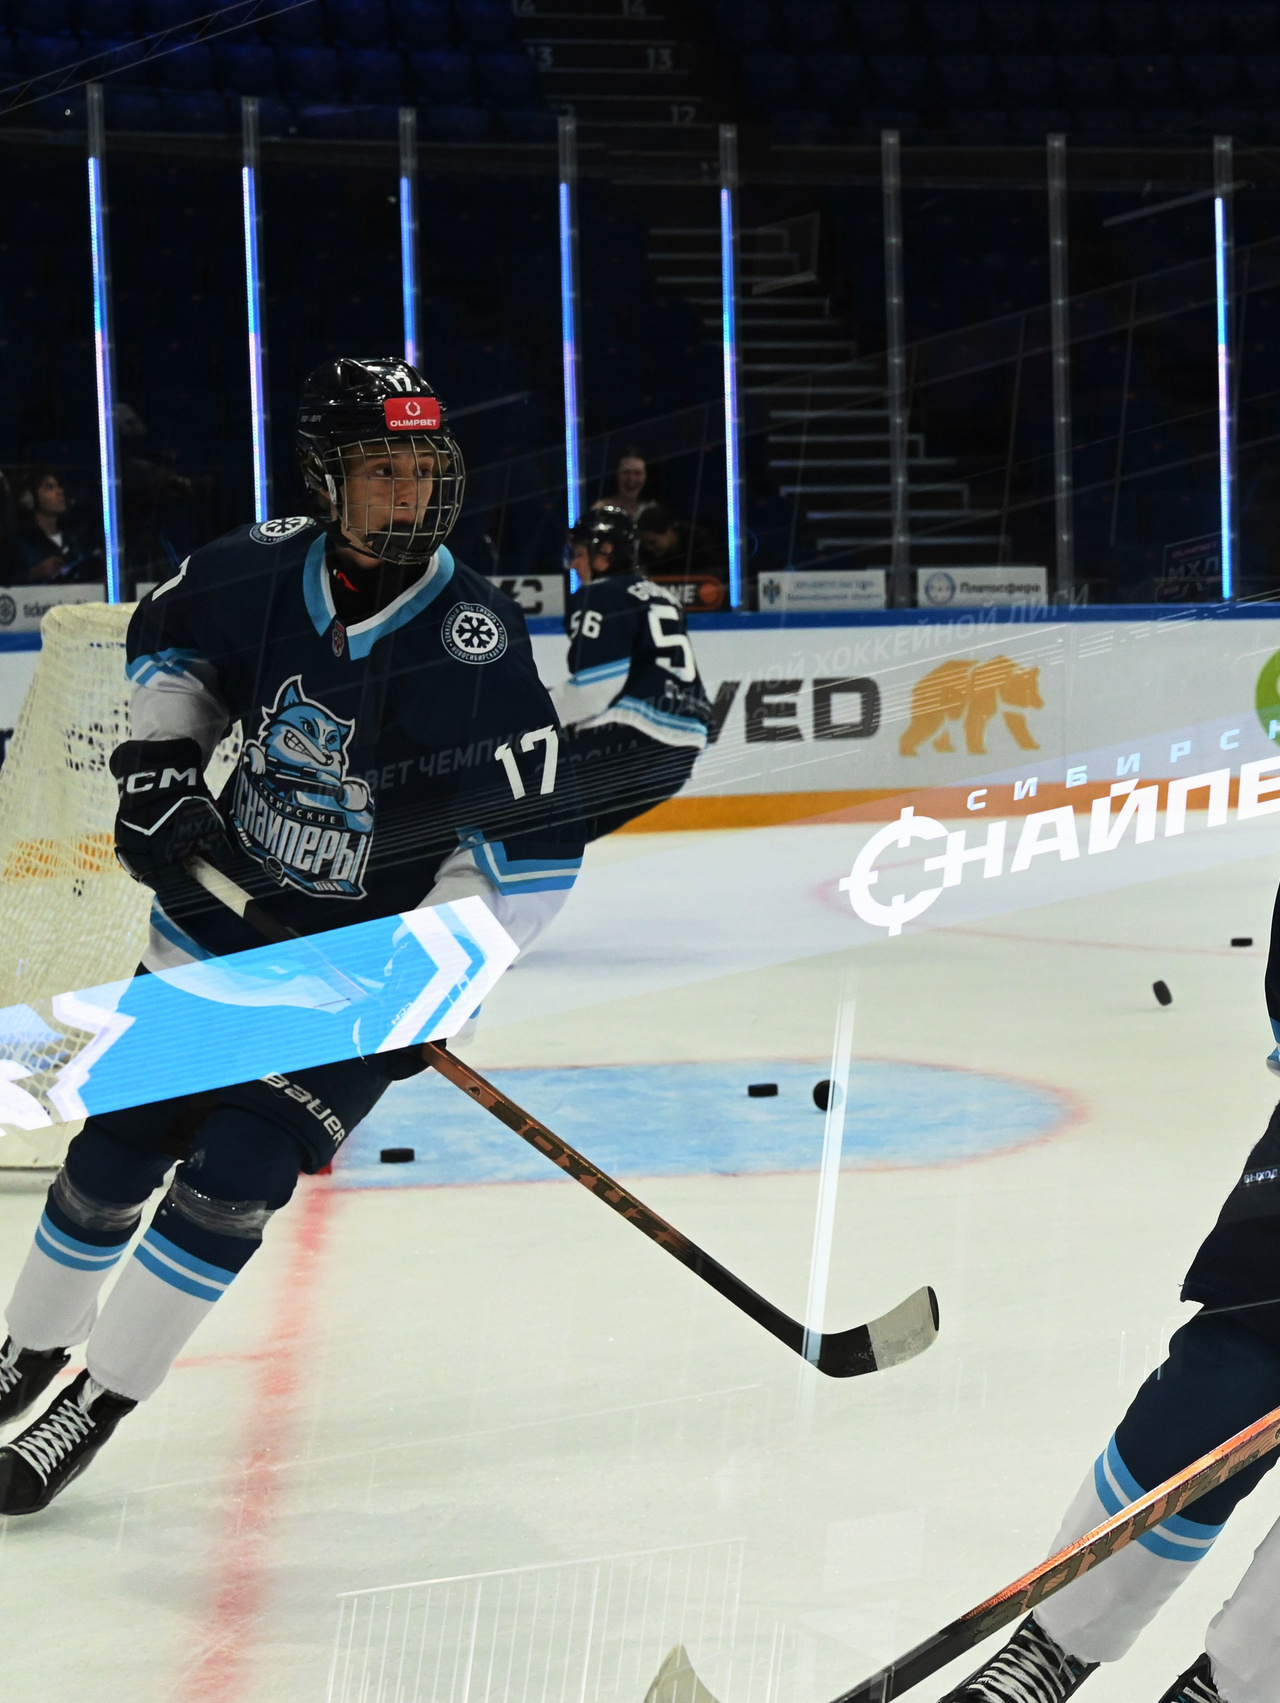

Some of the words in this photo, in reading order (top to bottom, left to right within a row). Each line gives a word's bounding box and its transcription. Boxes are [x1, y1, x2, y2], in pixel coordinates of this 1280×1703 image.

[646, 48, 673, 71] 13
[670, 105, 697, 124] 12
[386, 371, 412, 392] 17
[390, 418, 437, 427] OLIMPBET
[495, 724, 560, 801] 17
[258, 782, 337, 824] СИБИРСКИЕ
[236, 771, 367, 884] СНАЙПЕРЫ
[487, 1097, 668, 1243] SOYUZ
[1243, 1168, 1278, 1184] ВЫХОД
